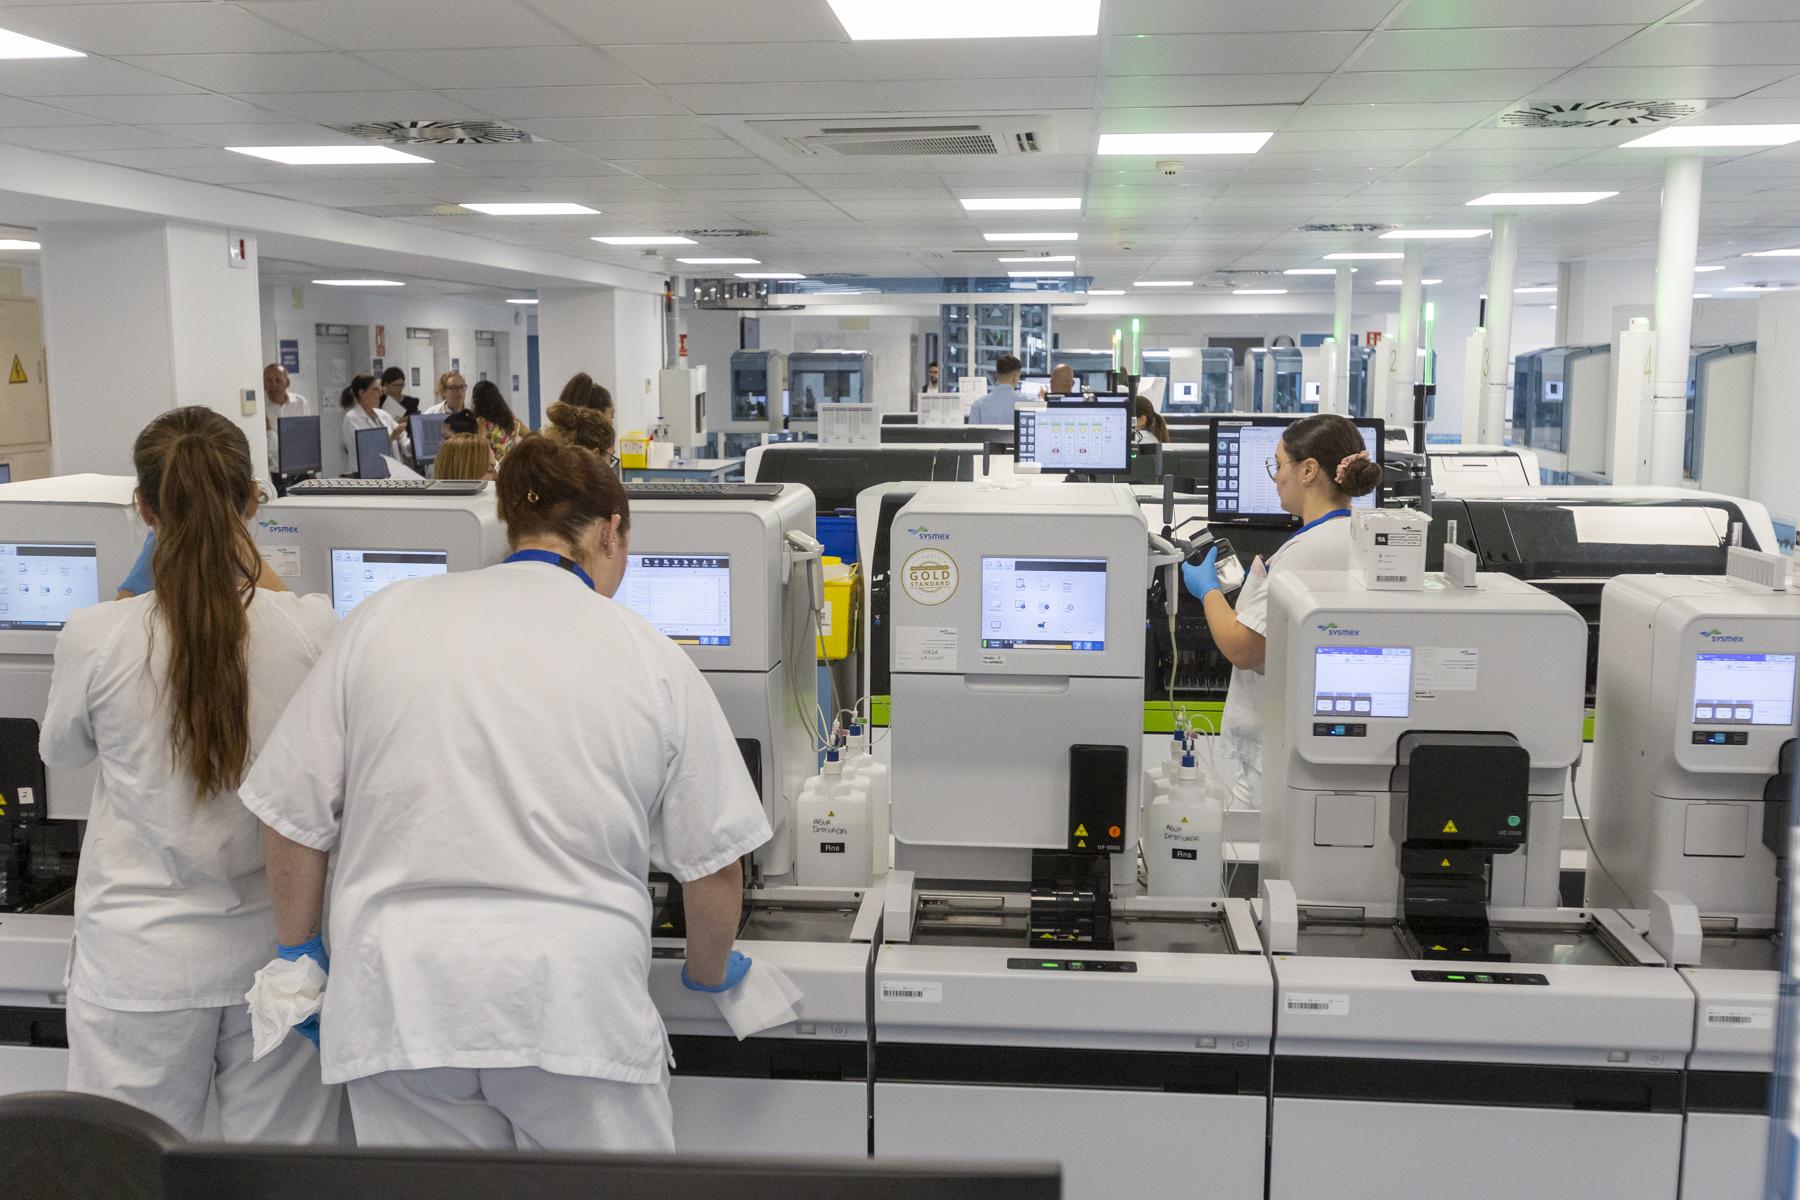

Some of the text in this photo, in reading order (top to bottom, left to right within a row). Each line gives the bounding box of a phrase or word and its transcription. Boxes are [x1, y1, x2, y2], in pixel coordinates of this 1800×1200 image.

[909, 571, 951, 581] GOLD
[1328, 629, 1360, 637] sysmex
[1711, 635, 1744, 643] sysmex
[825, 844, 841, 852] Rns
